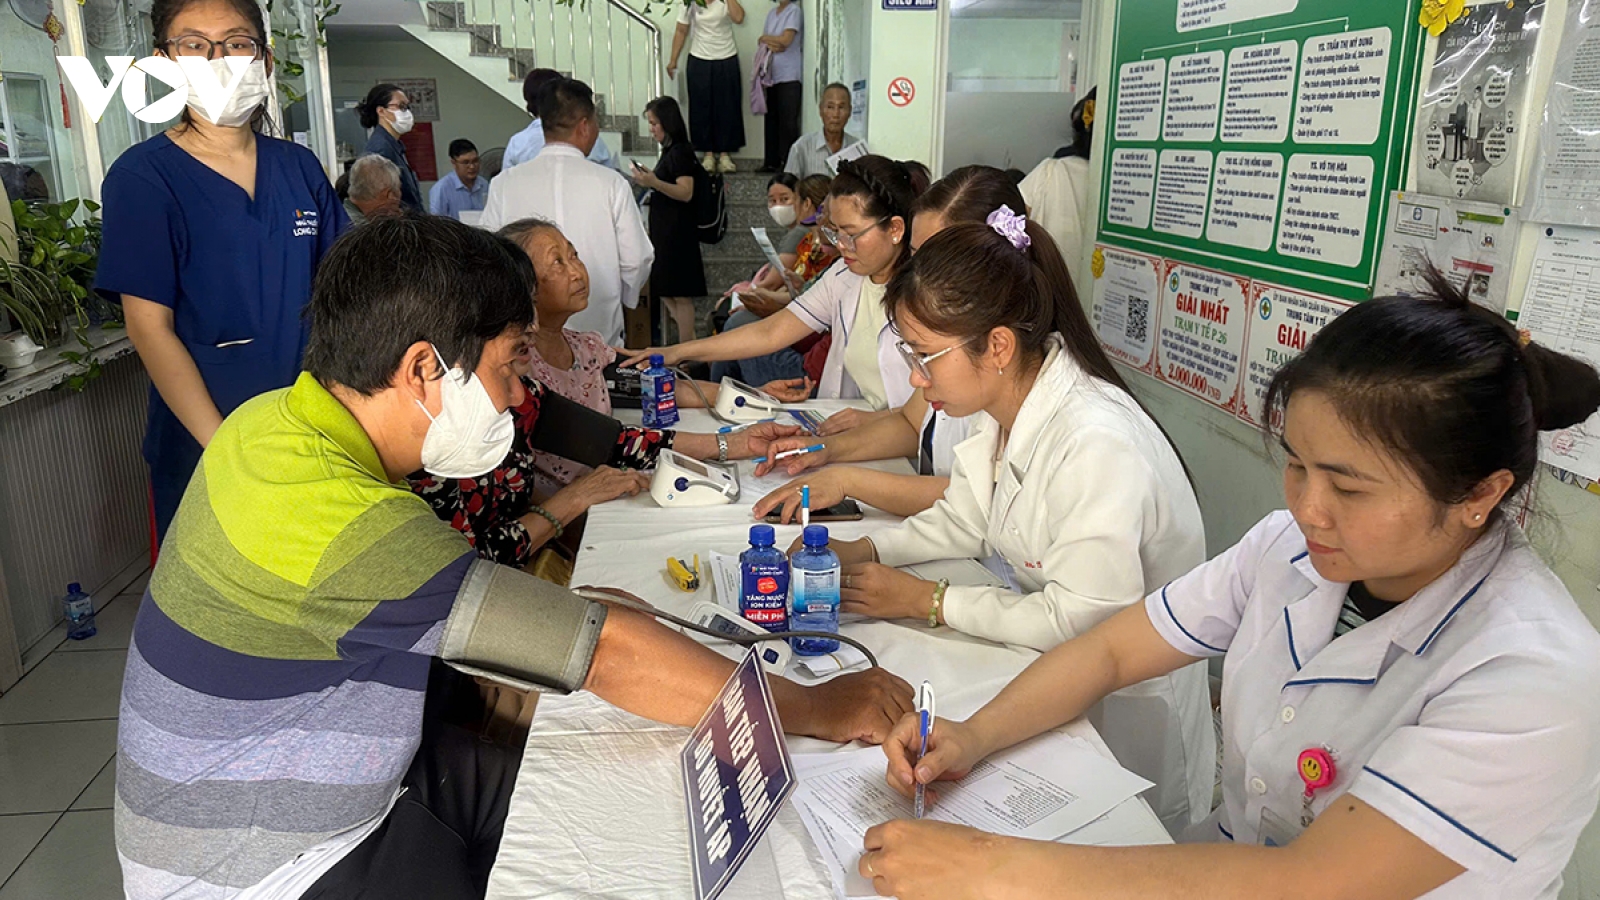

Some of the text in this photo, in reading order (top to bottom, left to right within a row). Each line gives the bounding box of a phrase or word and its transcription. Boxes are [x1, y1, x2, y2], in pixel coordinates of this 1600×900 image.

[1176, 290, 1198, 316] GIẢI
[1199, 298, 1230, 326] NHẤT
[1174, 315, 1194, 334] TRẠM
[1194, 322, 1201, 335] Y
[1201, 320, 1212, 340] TẾ
[1277, 322, 1307, 352] GIẢI
[1168, 362, 1207, 394] 2.000.000
[746, 610, 769, 621] MIỄN
